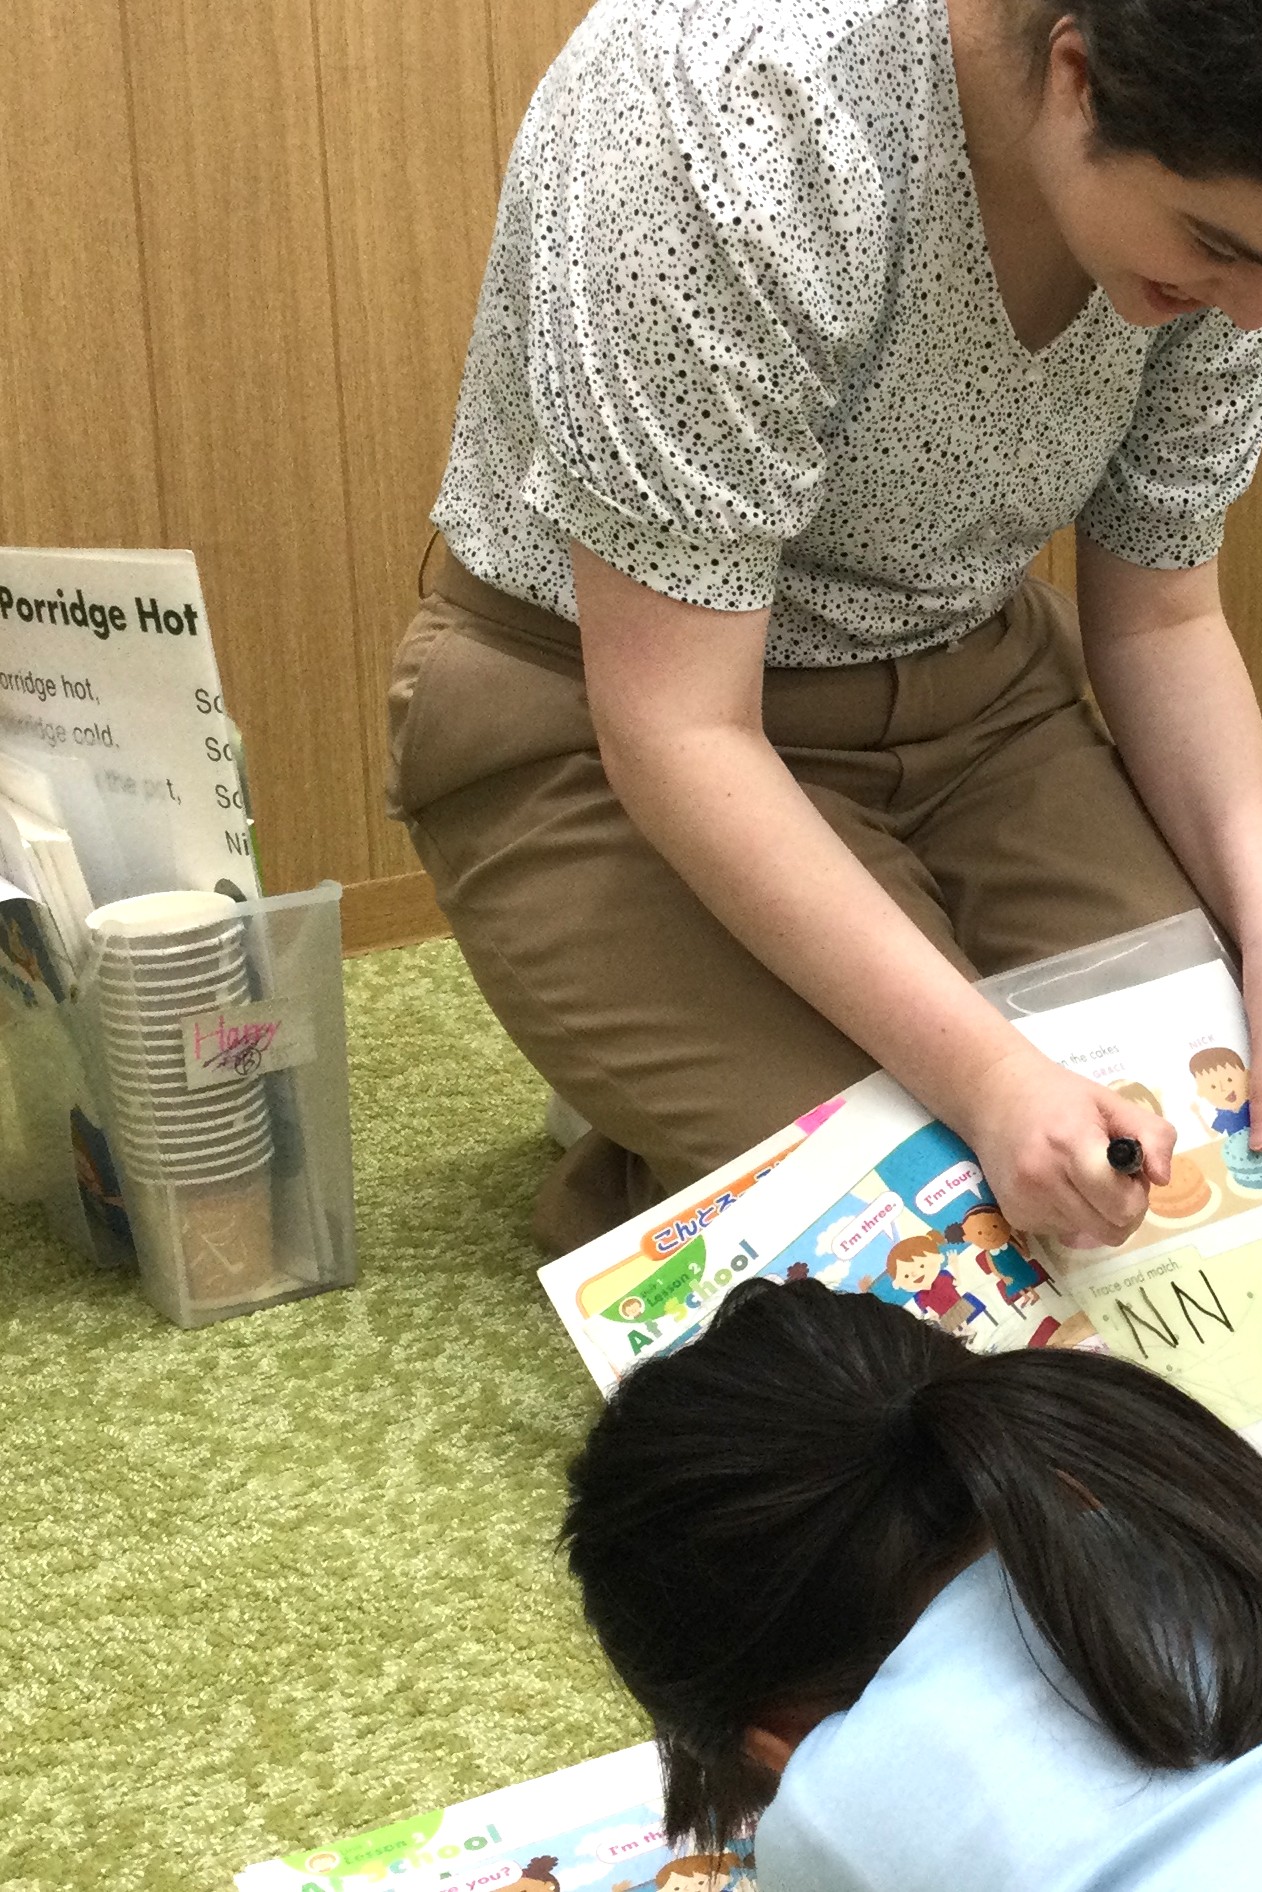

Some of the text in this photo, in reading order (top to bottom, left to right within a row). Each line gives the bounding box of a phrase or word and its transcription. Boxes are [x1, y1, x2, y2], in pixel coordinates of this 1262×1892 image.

[135, 597, 199, 636] Hot
[61, 675, 100, 705] hot,
[1189, 1034, 1215, 1049] NICK
[1070, 1053, 1088, 1064] the
[924, 1170, 977, 1206] I'm four.
[840, 1202, 896, 1252] I'm three.
[688, 1262, 702, 1275] 2
[628, 1239, 760, 1356] At School
[1089, 1281, 1122, 1298] Trace
[1123, 1270, 1145, 1287] and
[344, 1841, 408, 1865] Lesson
[359, 1823, 503, 1883] School
[608, 1840, 640, 1857] I'm
[466, 1866, 512, 1891] you?
